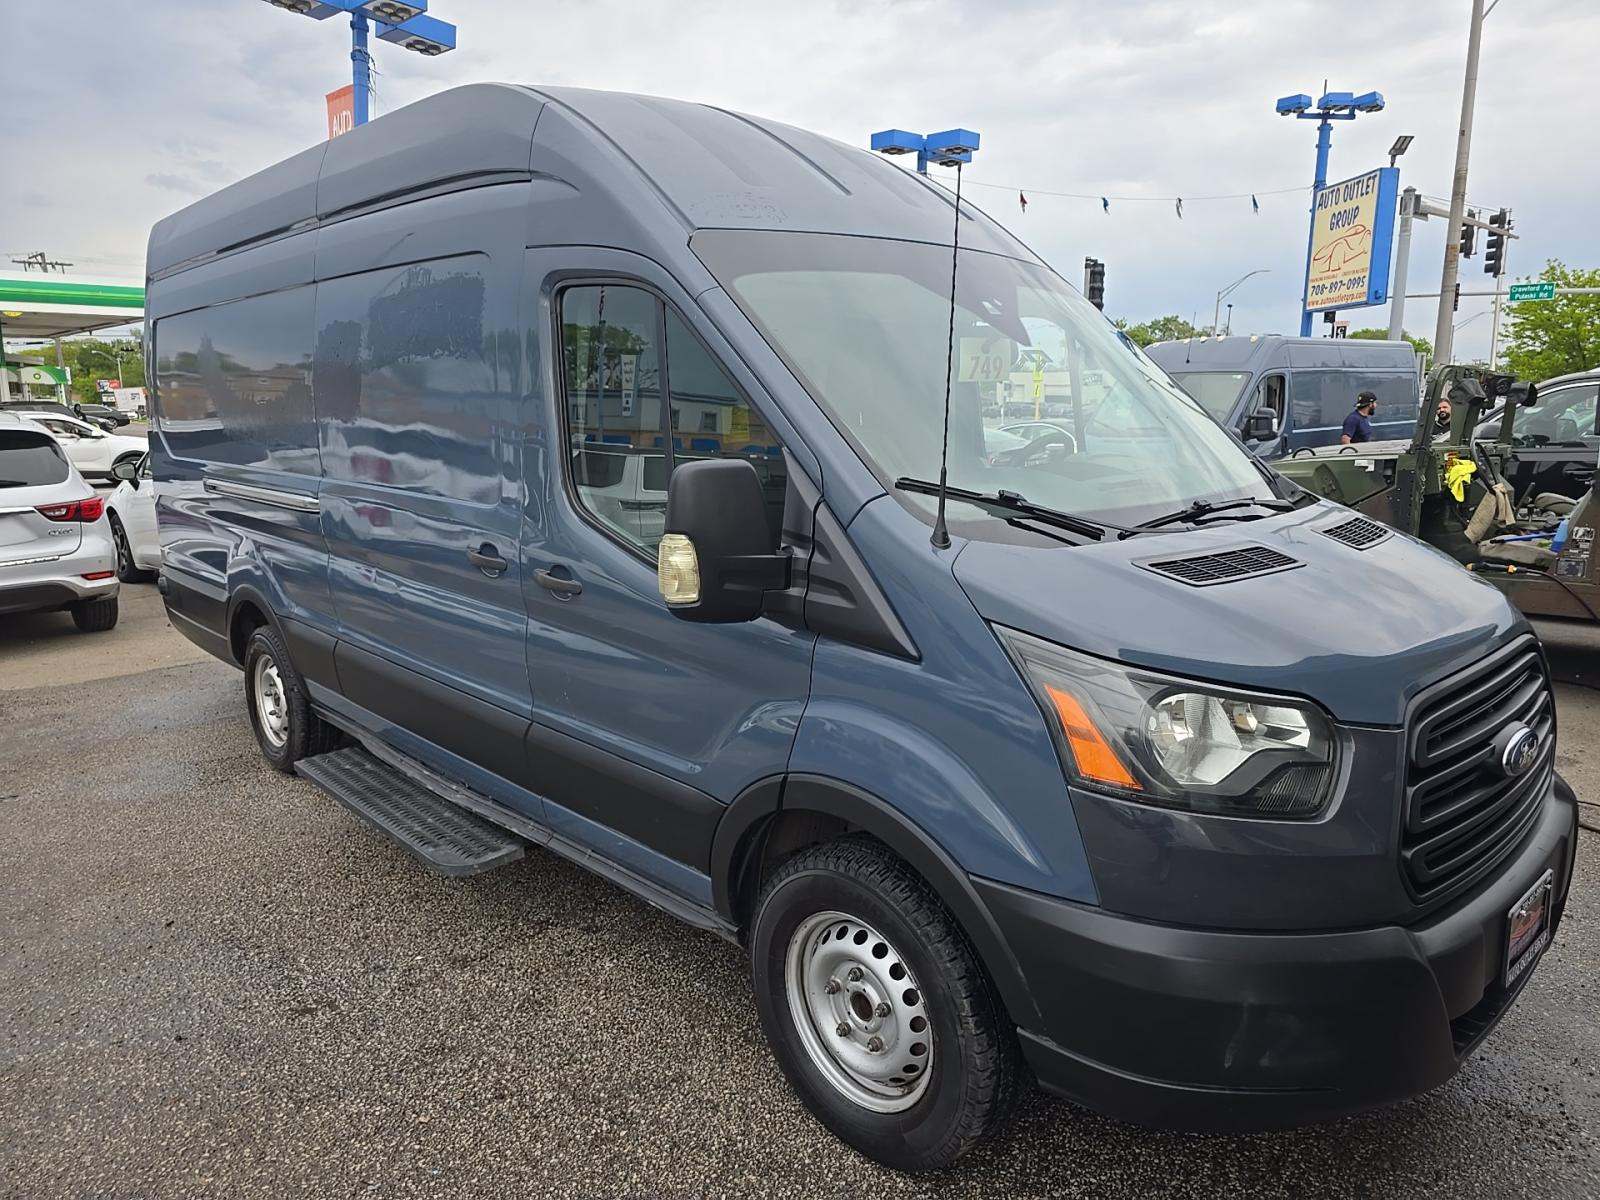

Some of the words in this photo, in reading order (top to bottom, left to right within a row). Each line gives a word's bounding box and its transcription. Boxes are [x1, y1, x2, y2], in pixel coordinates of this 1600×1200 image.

[1317, 187, 1341, 211] AUTO
[1343, 174, 1378, 203] OUTLET
[1329, 205, 1360, 231] GROUP
[1311, 275, 1366, 296] 708-897-0995
[1512, 284, 1540, 293] Crawford
[967, 355, 1004, 380] 749
